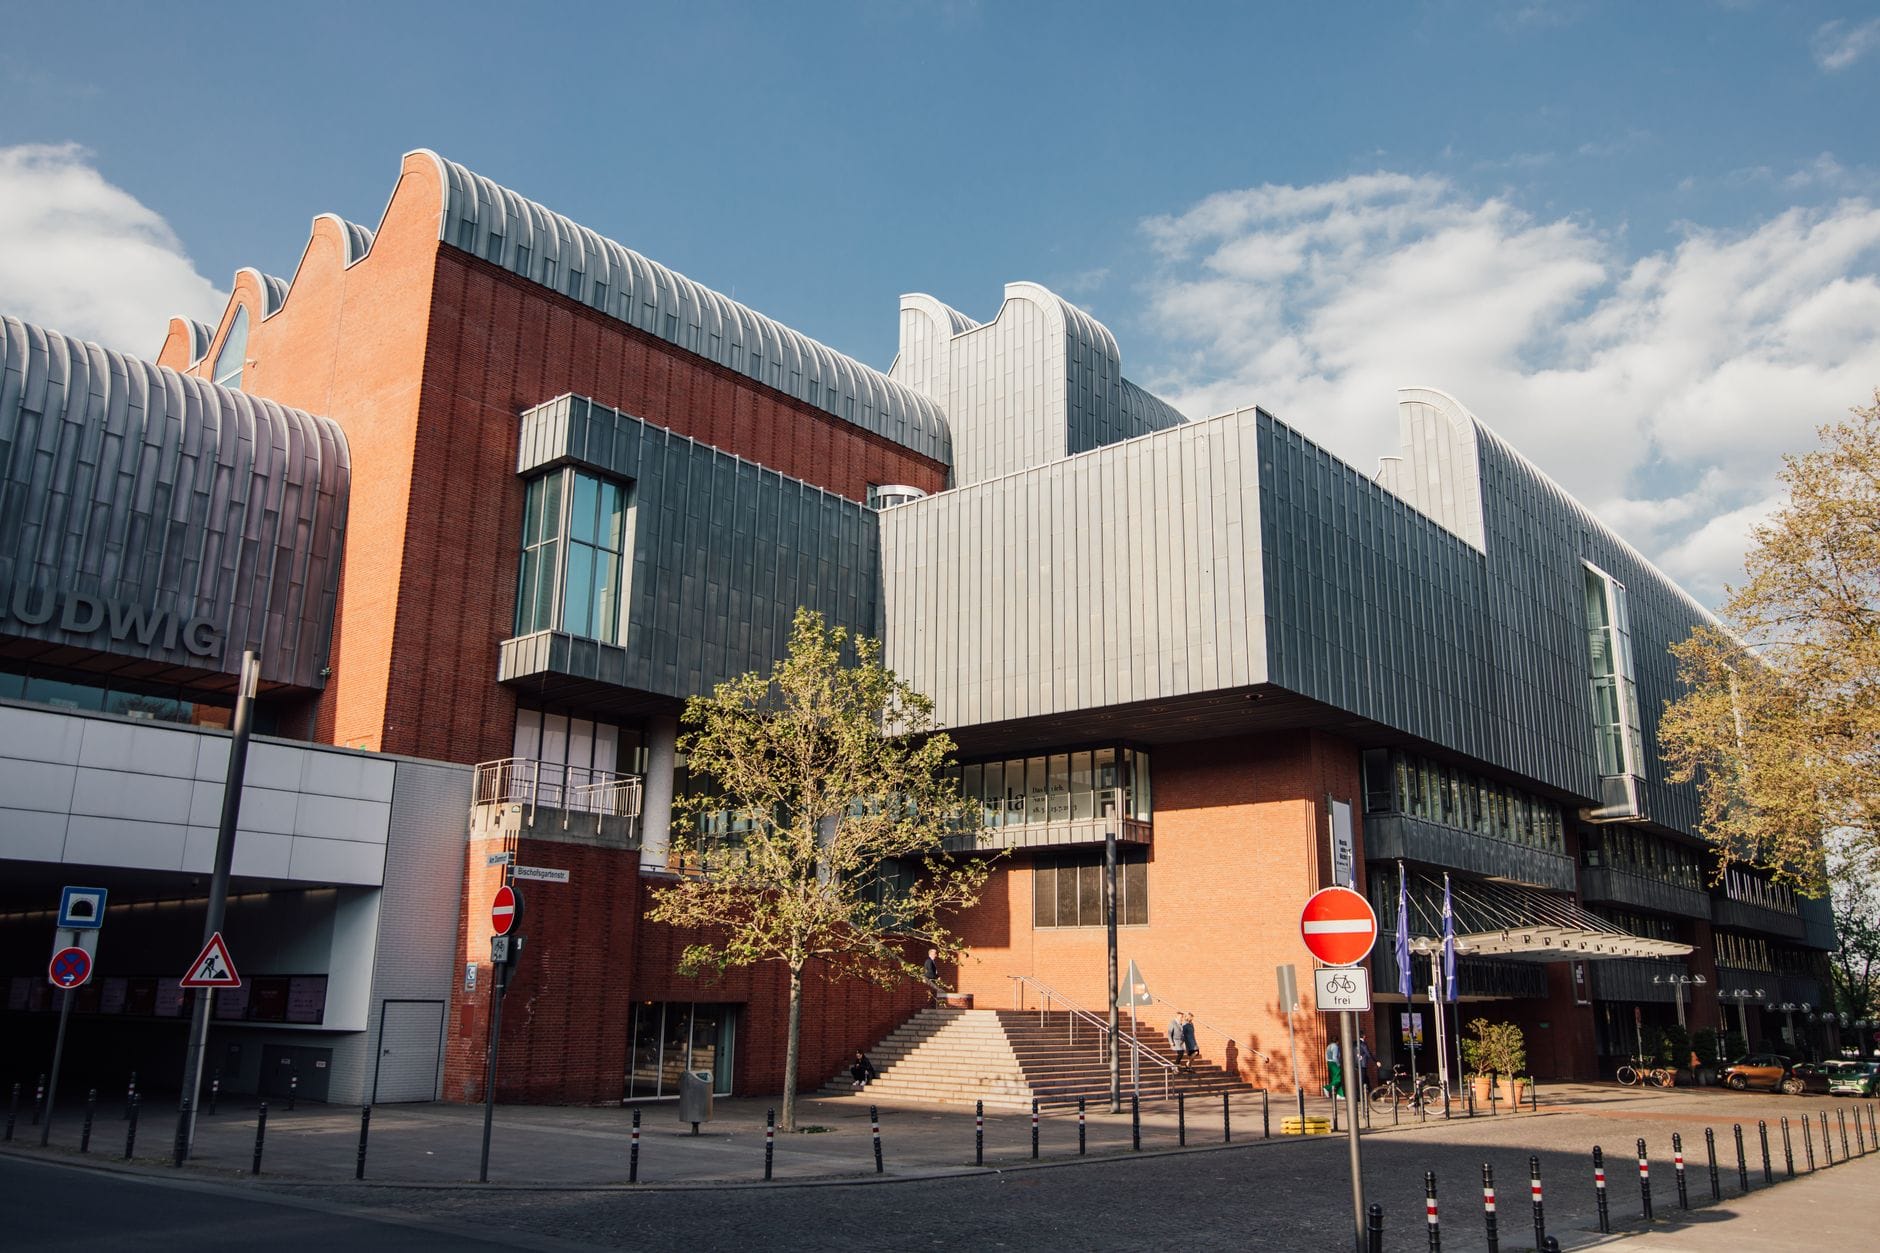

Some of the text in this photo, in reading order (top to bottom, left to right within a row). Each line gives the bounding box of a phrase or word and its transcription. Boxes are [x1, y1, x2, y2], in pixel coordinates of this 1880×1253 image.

[0, 579, 226, 658] UDWIG
[517, 867, 567, 880] Bischofsgartenstr.
[1334, 995, 1351, 1005] frei
